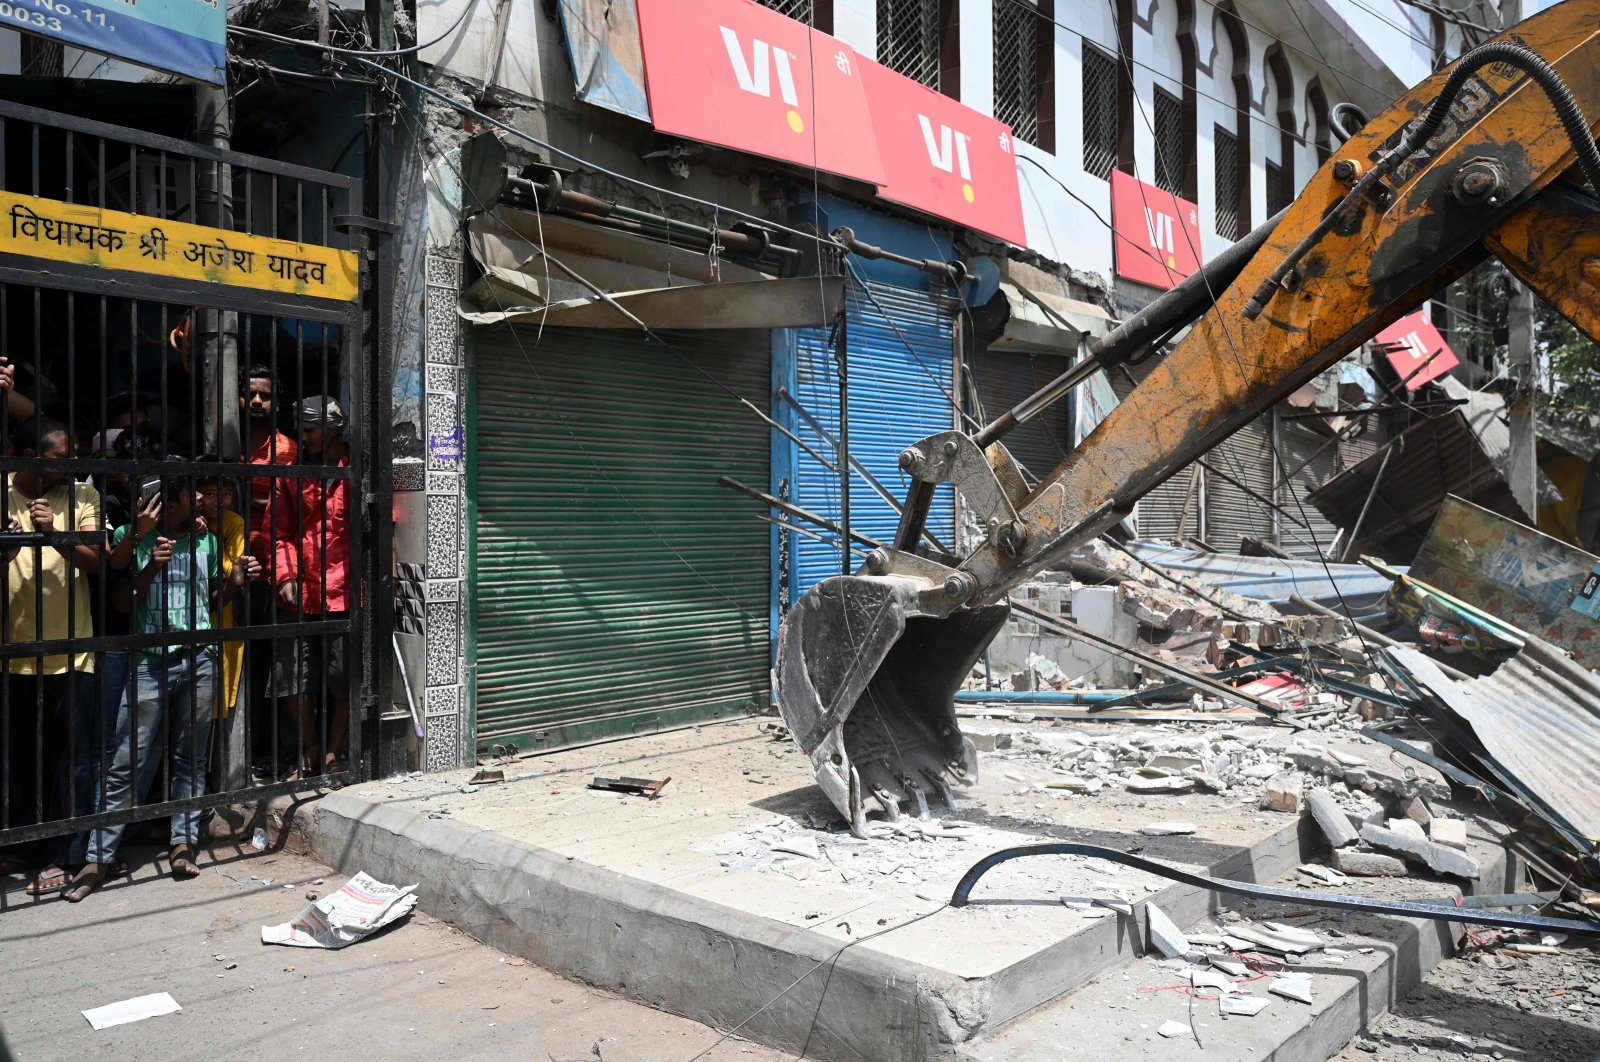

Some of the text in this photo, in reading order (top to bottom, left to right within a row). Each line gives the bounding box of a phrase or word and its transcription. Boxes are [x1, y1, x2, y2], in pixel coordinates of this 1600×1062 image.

[834, 51, 851, 76] वी
[998, 132, 1011, 154] वी
[9, 204, 327, 285] विधायक श्री अजेश यादव
